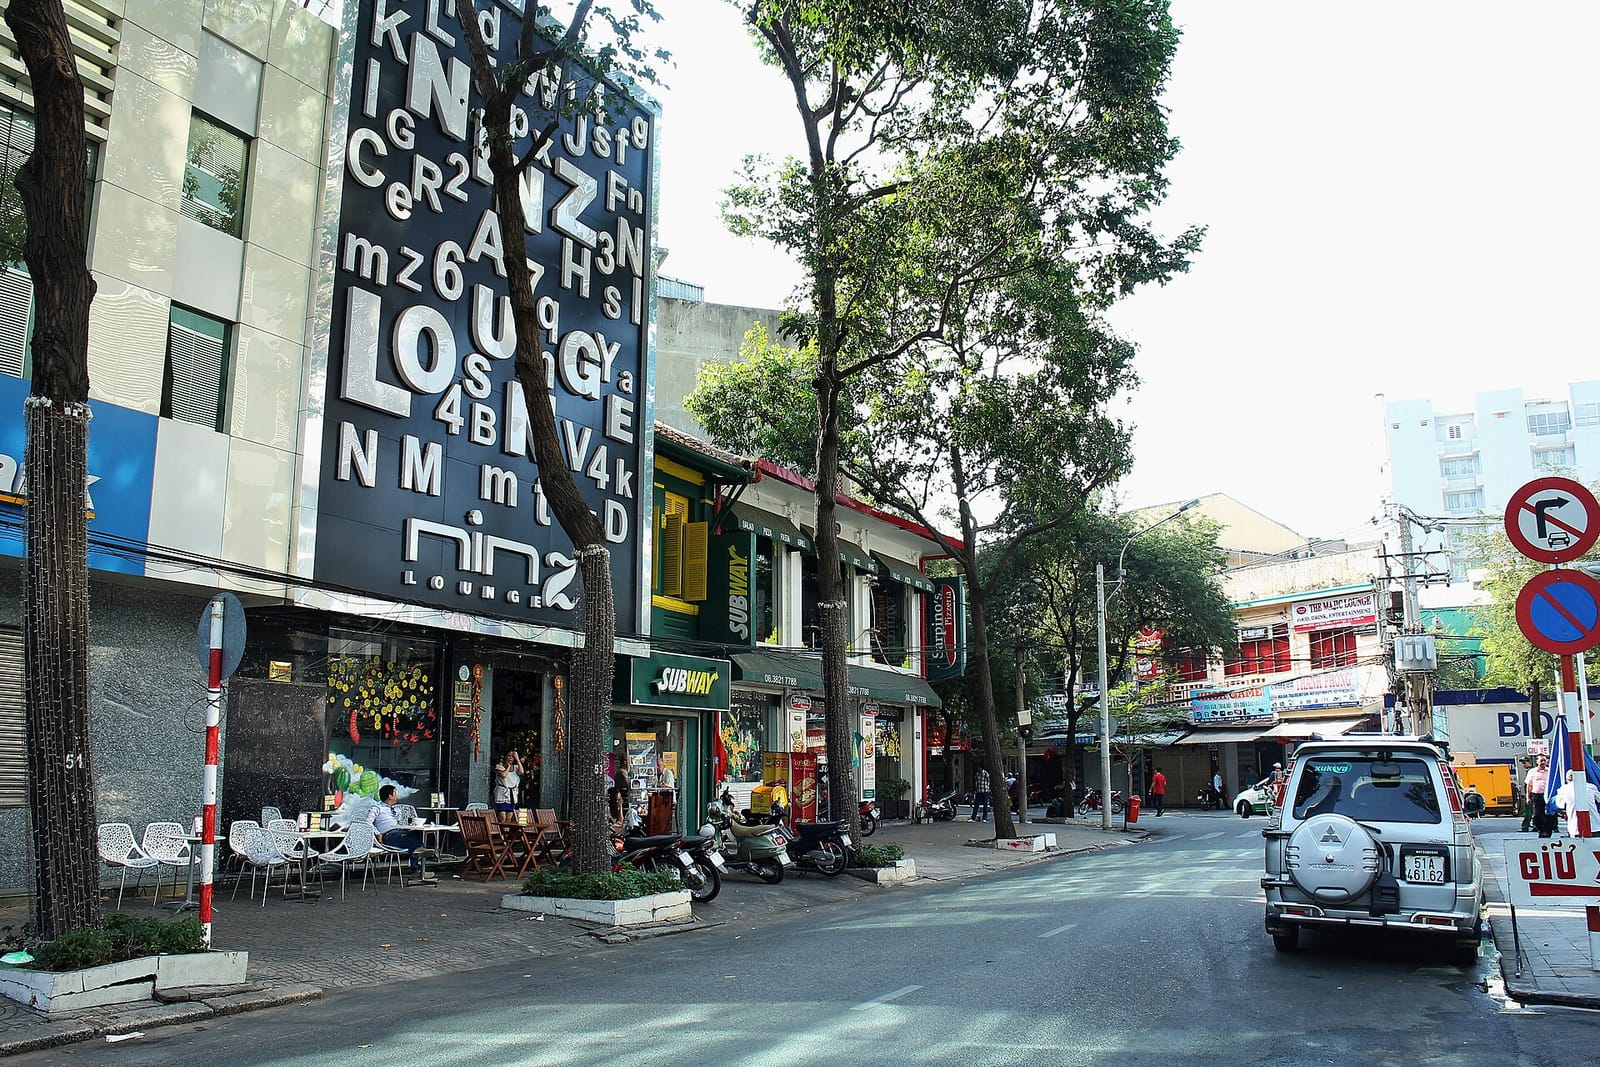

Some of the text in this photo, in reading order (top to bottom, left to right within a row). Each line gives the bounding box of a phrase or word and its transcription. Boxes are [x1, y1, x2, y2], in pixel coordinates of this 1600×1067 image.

[404, 571, 543, 609] LOUNGE
[727, 544, 749, 641] SUBWAY
[1309, 602, 1323, 614] THE
[1344, 595, 1372, 609] LOUNGE
[944, 591, 953, 626] Pizzeria
[931, 592, 947, 660] Sarpino's
[657, 667, 720, 696] SUBWAY
[65, 753, 83, 769] 51
[1407, 868, 1443, 882] 461.62
[1414, 857, 1435, 870] 51A
